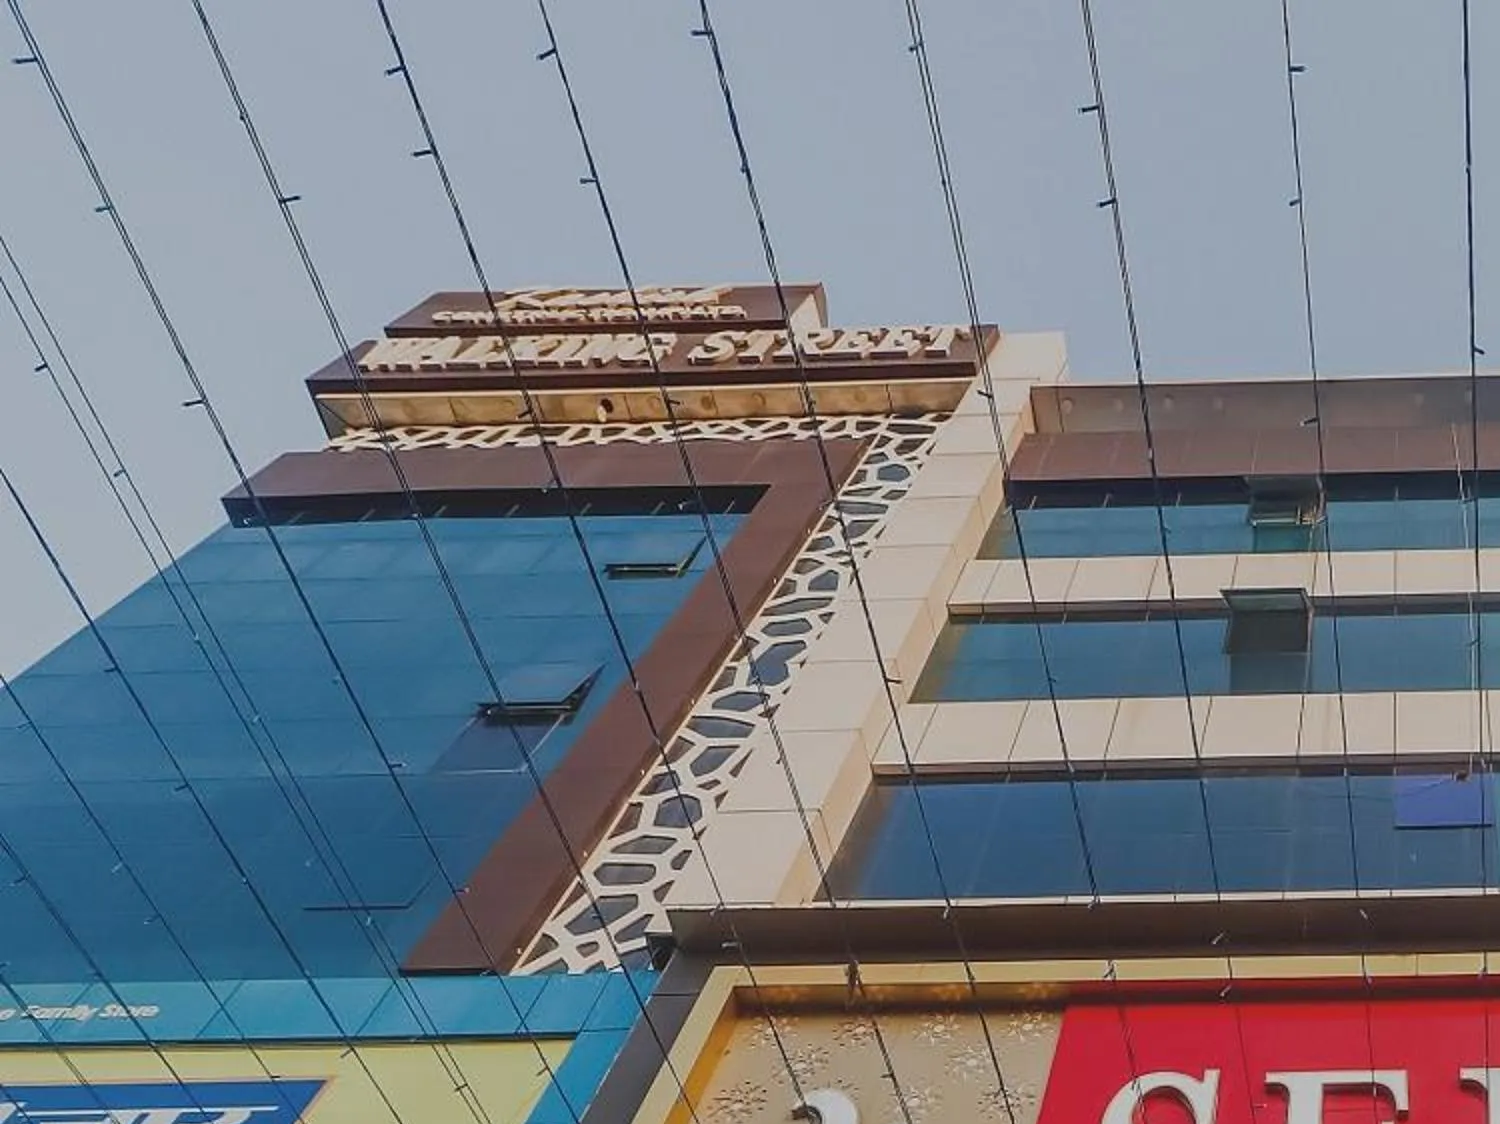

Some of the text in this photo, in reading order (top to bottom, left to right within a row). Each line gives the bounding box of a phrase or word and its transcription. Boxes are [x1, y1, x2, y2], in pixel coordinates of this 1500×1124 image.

[356, 323, 970, 372] WALKING STREET
[20, 1004, 98, 1023] Family
[98, 1003, 160, 1020] Store
